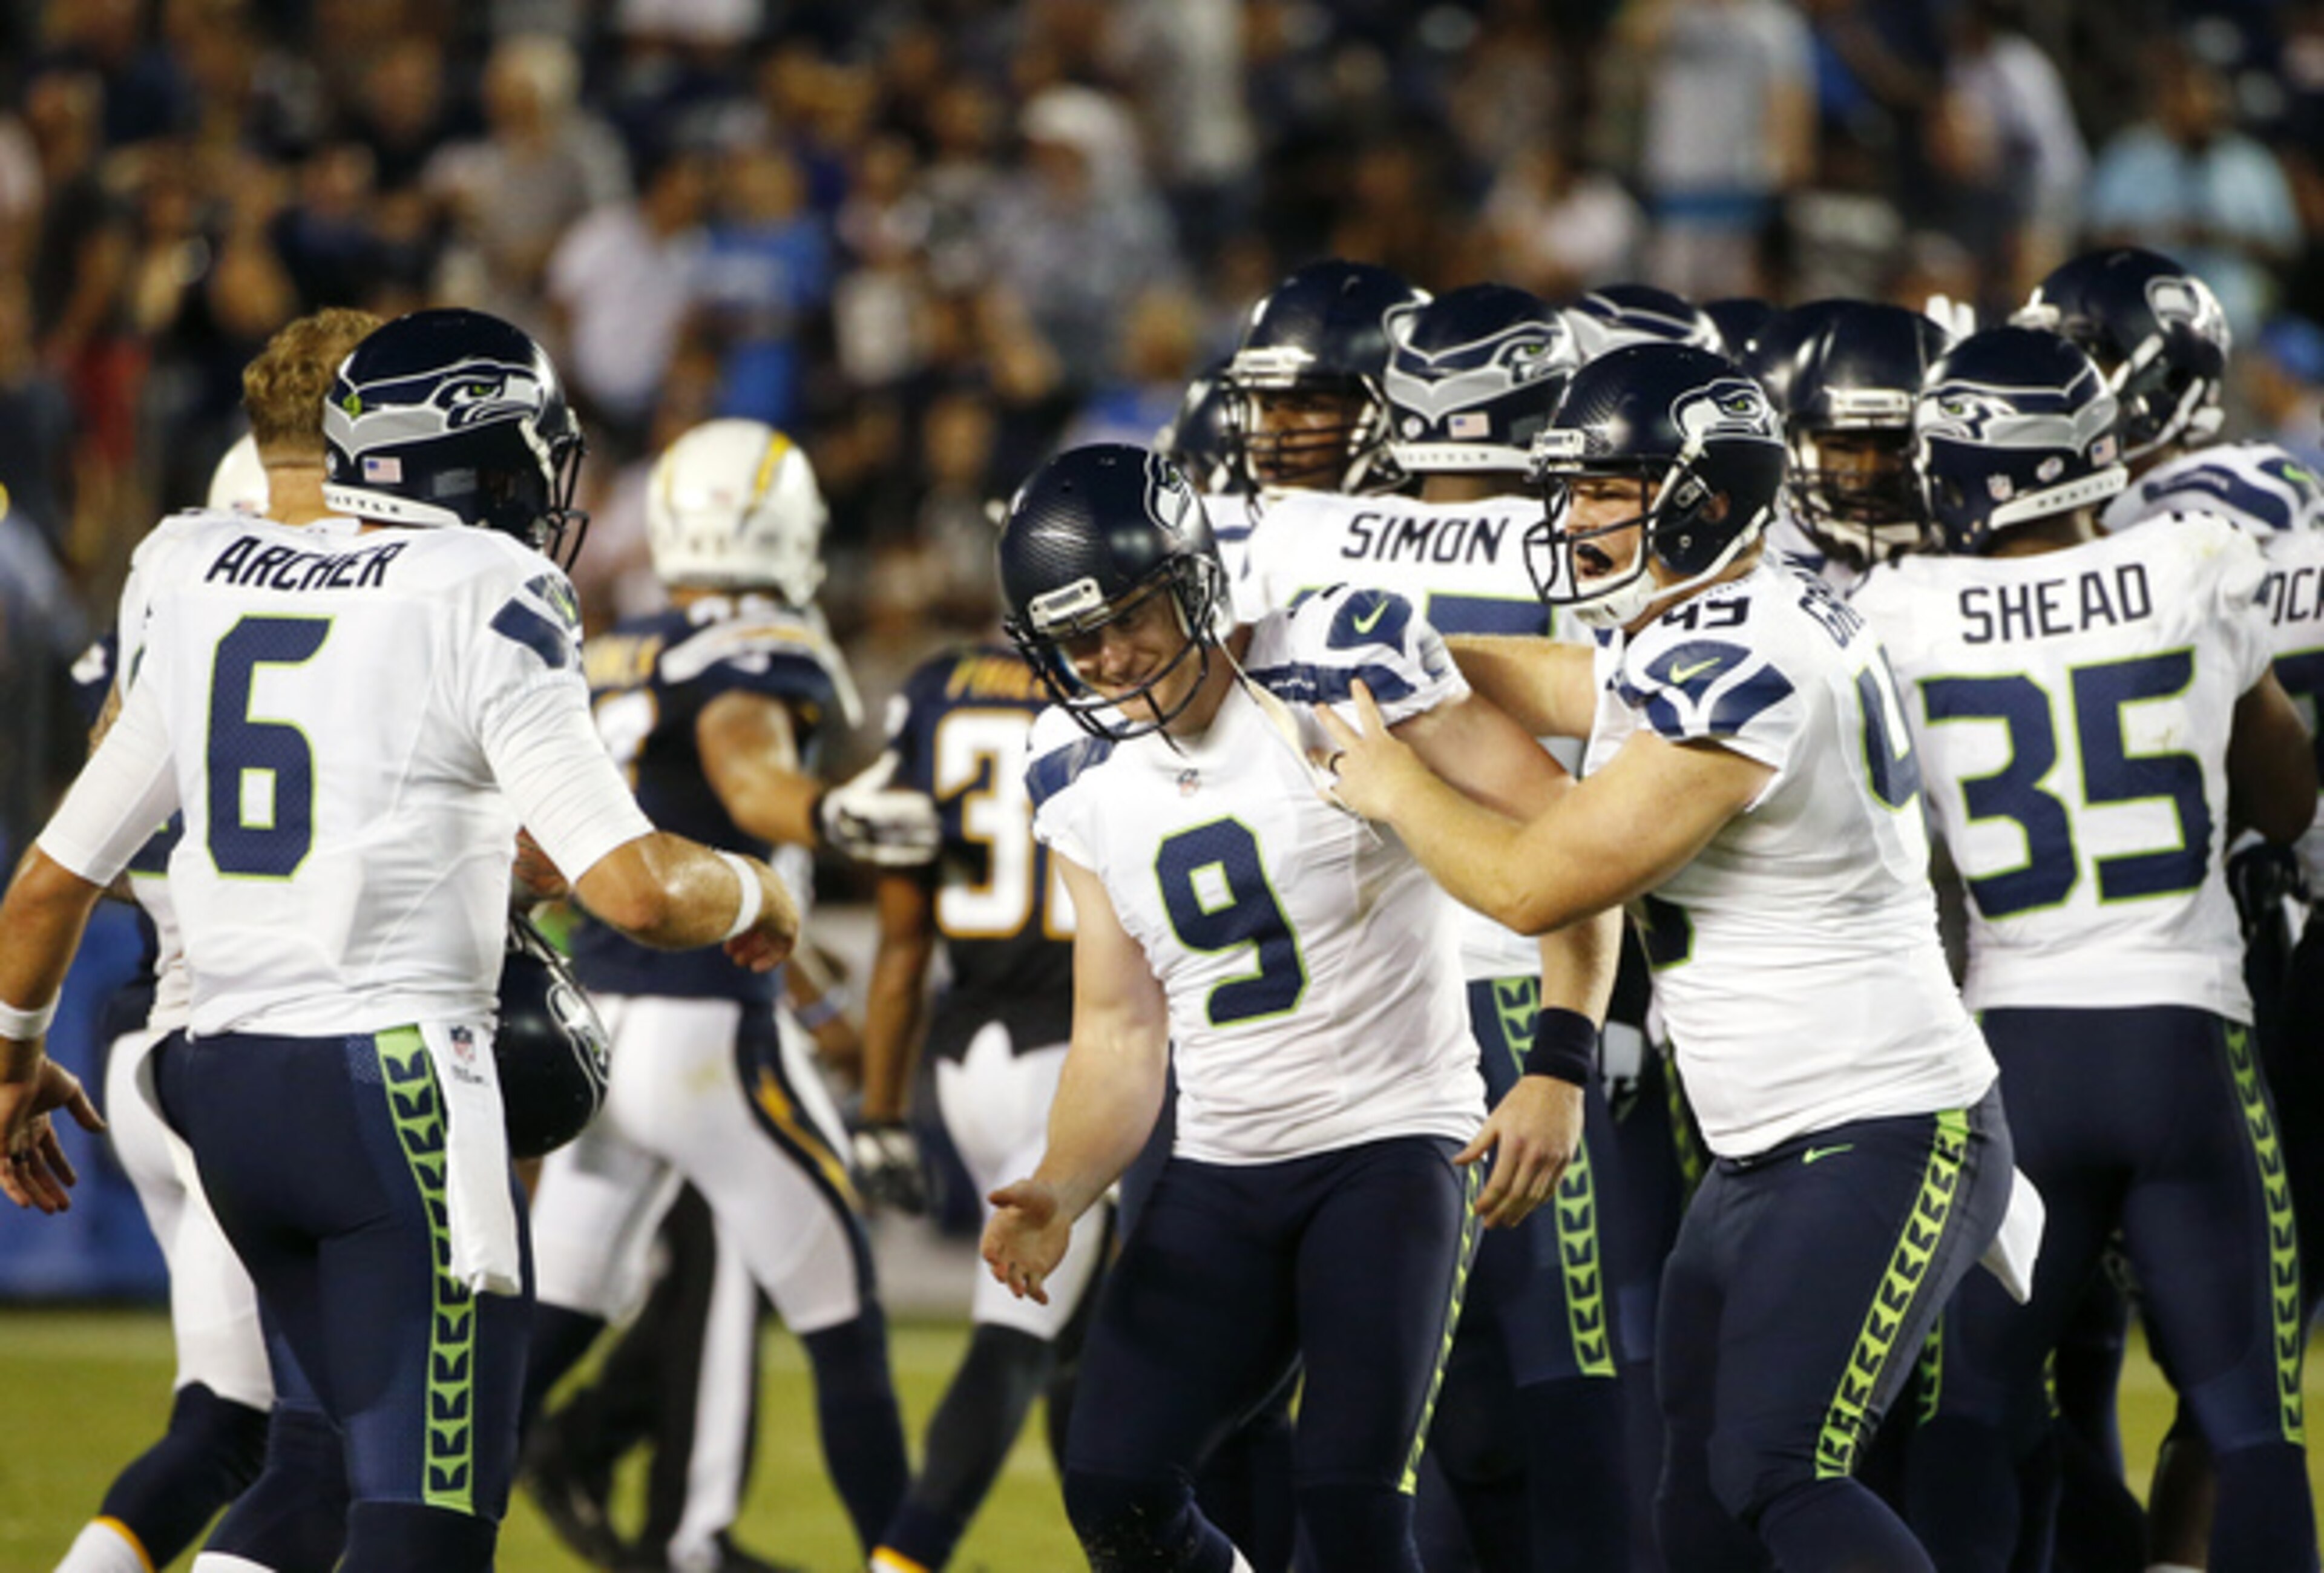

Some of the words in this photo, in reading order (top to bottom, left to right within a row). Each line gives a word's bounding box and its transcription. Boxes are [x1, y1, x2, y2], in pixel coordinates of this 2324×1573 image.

[204, 535, 410, 591] ARCHER
[1340, 511, 1510, 564] SIMON
[1958, 562, 2153, 644] SHEAD
[203, 612, 337, 883] 6
[1914, 644, 2214, 923] 35
[1153, 813, 1309, 1027] 9
